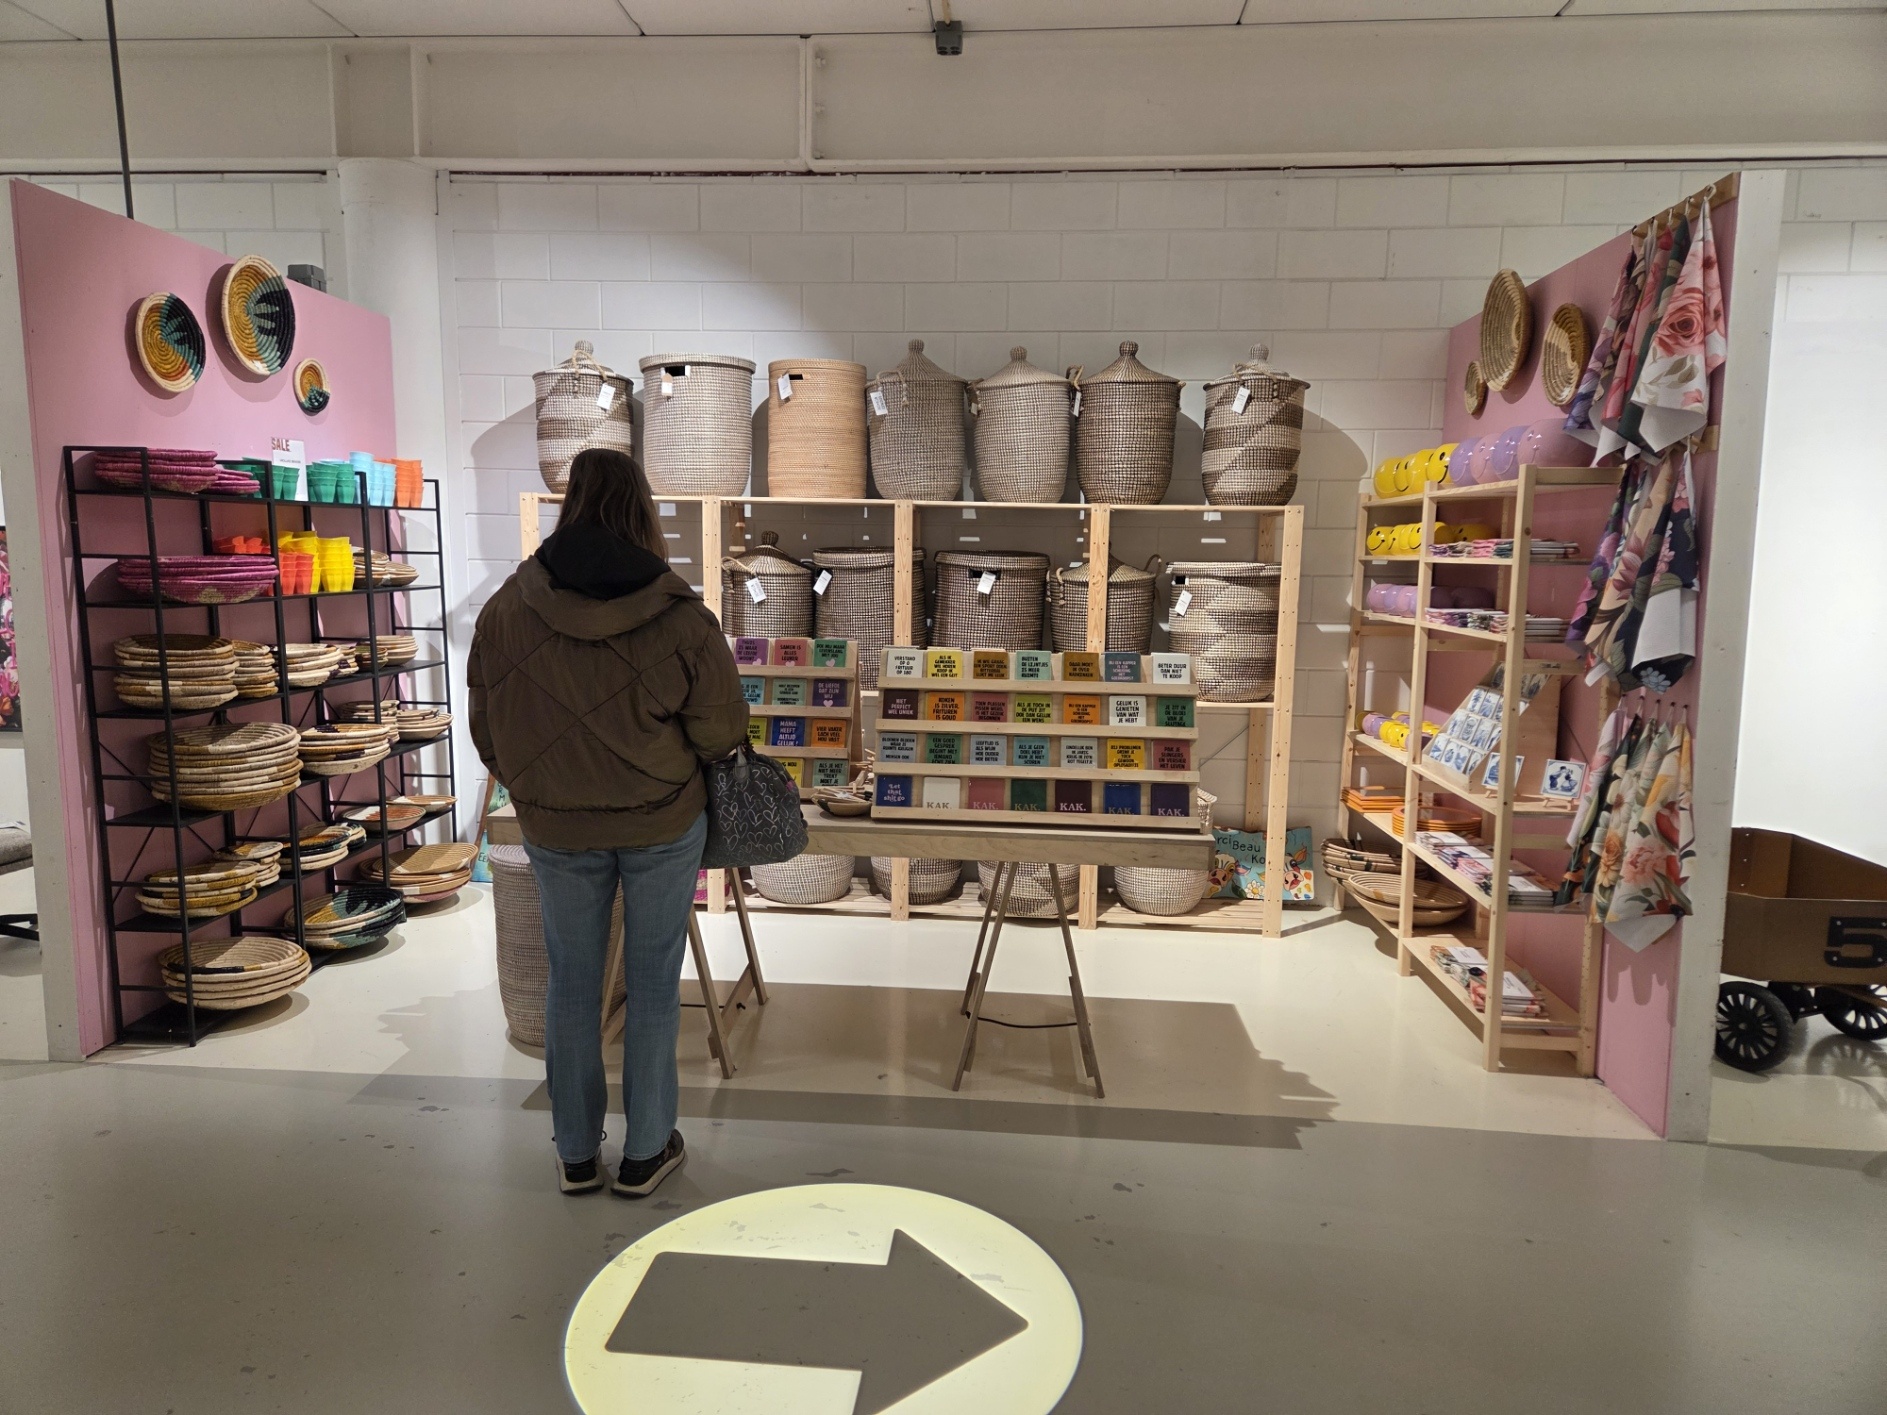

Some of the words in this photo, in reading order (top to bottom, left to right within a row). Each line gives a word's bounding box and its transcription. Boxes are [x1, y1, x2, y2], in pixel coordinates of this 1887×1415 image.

[271, 436, 290, 452] SALE
[973, 802, 999, 810] KAK.
[1060, 803, 1086, 811] KAK.
[1108, 807, 1135, 815] KAK.
[1157, 808, 1185, 817] KAK.
[1217, 835, 1232, 845] rci
[1232, 840, 1260, 852] Beau
[1251, 854, 1266, 864] Ko
[1824, 916, 1887, 968] 5
